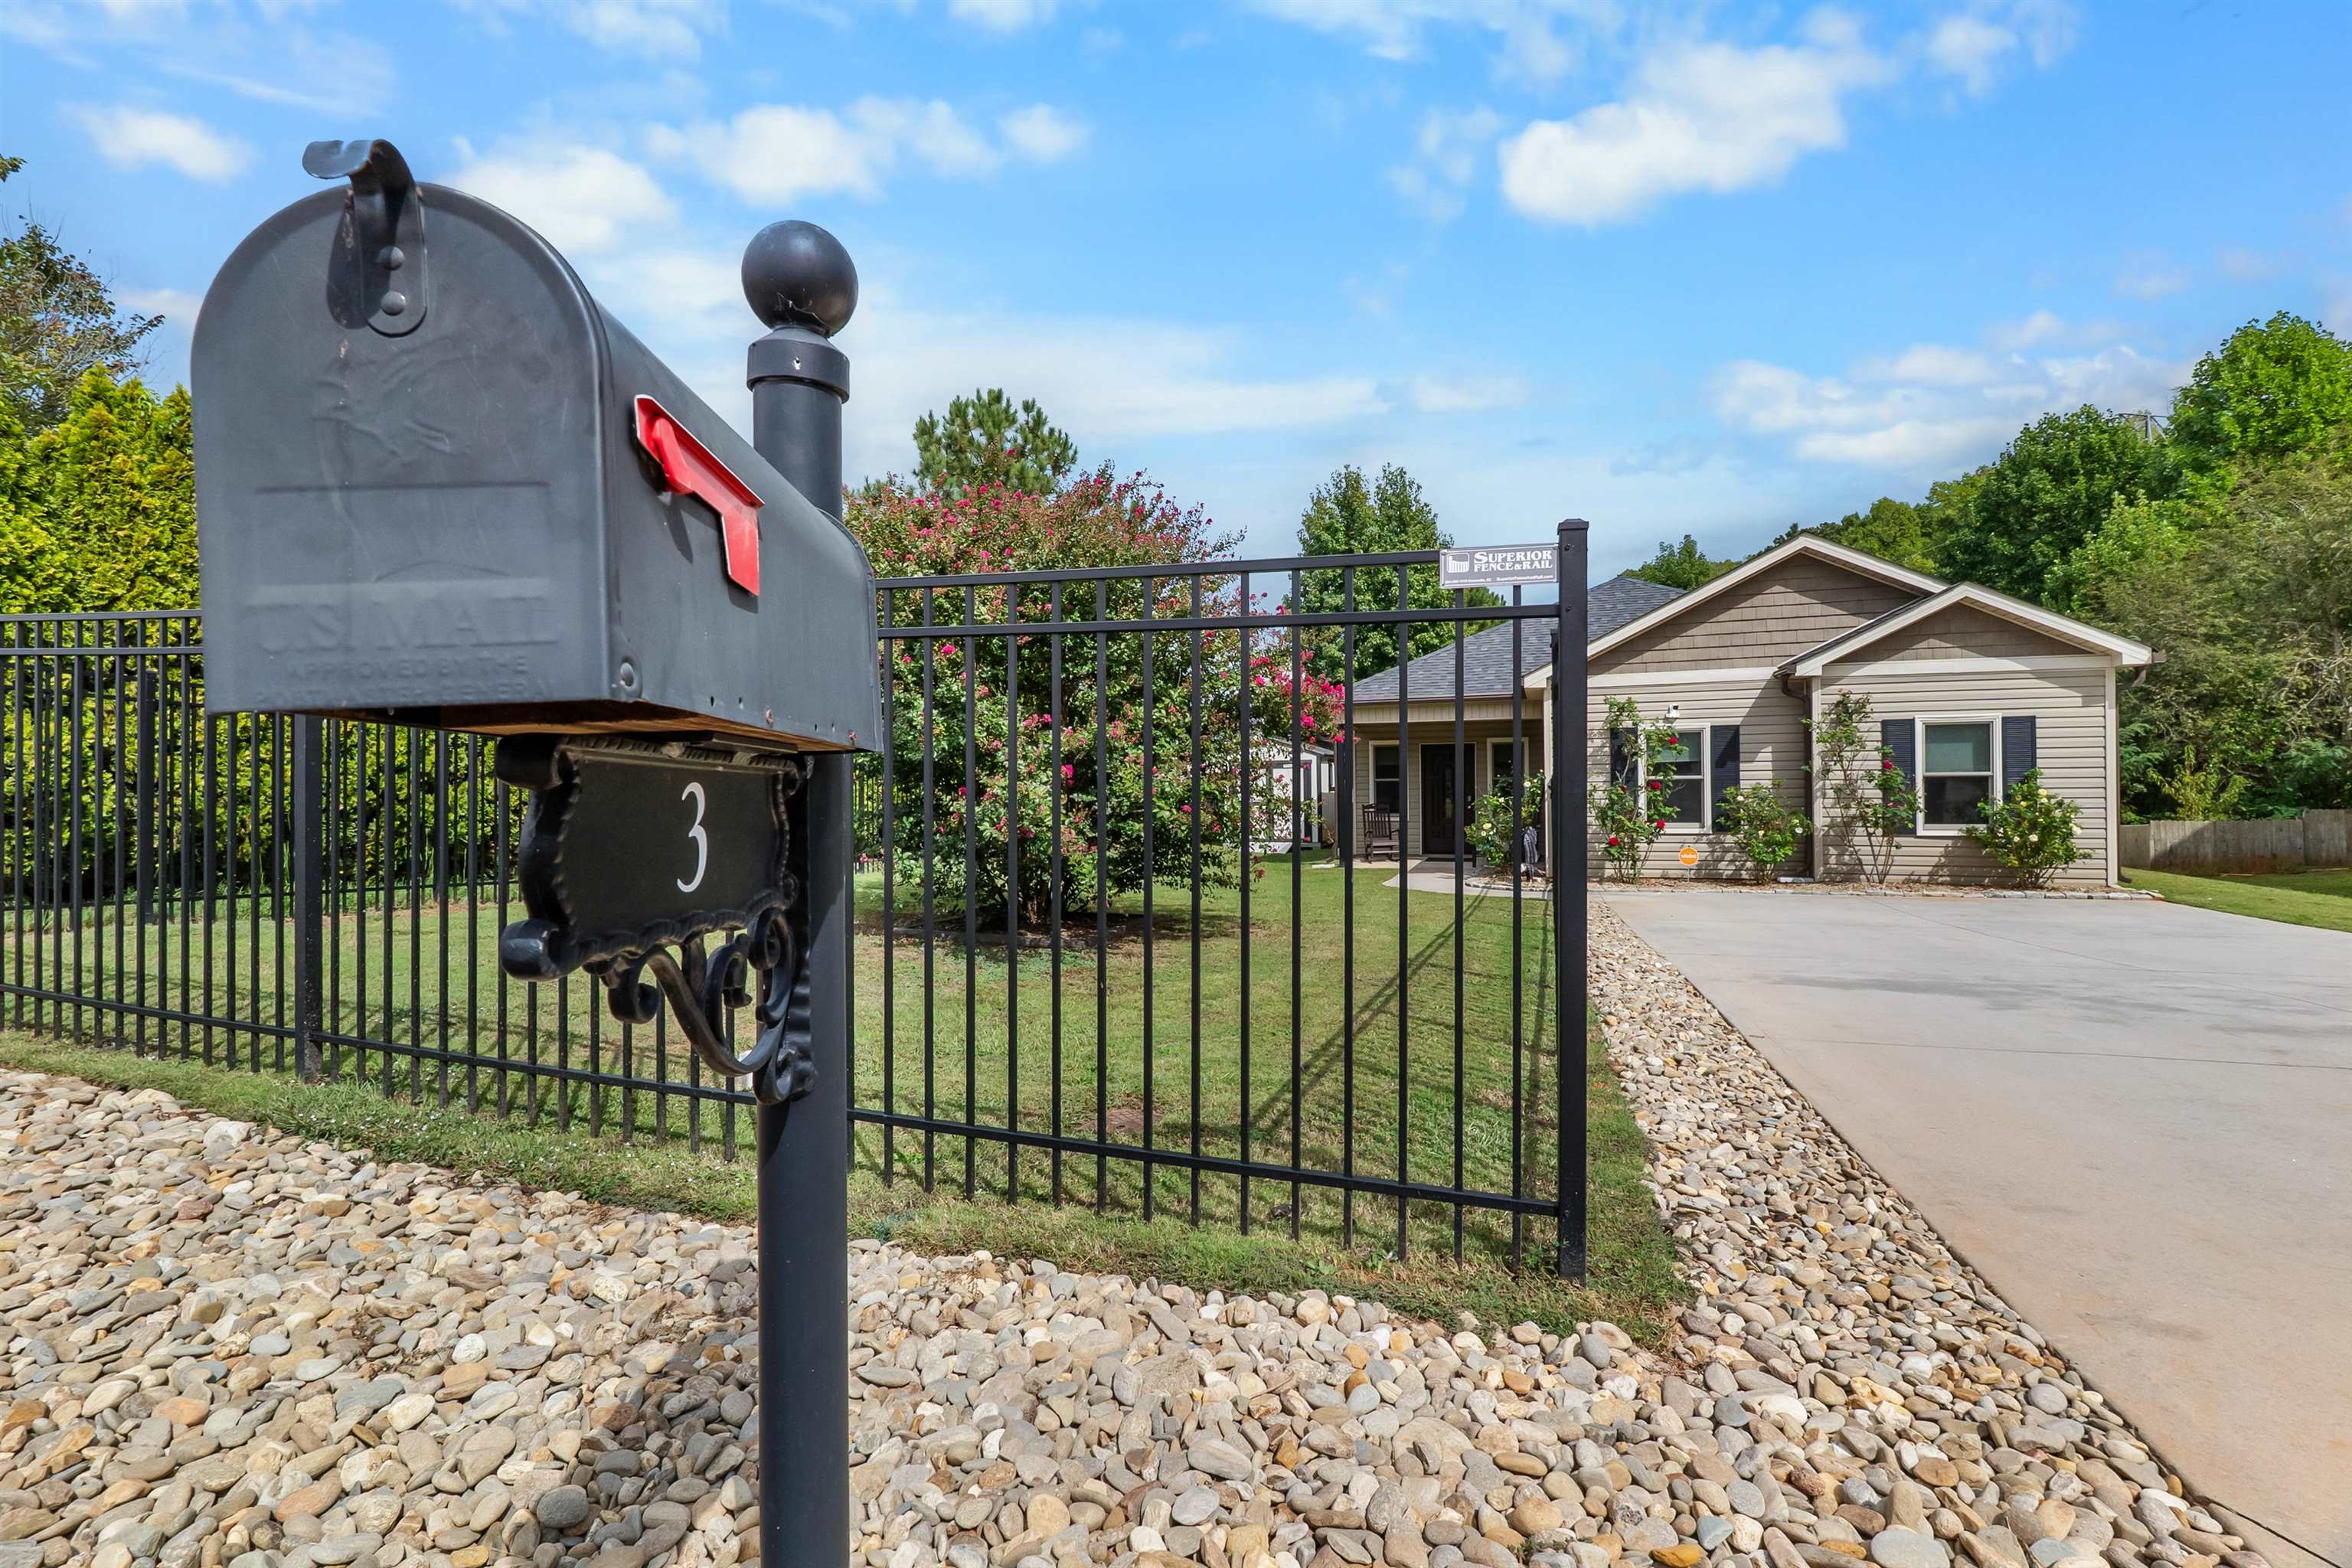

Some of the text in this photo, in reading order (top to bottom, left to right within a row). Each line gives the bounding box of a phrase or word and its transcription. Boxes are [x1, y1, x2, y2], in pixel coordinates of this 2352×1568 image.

[1473, 550, 1553, 564] SUPERIOR
[368, 595, 560, 651] MAIL
[677, 782, 707, 893] 3
